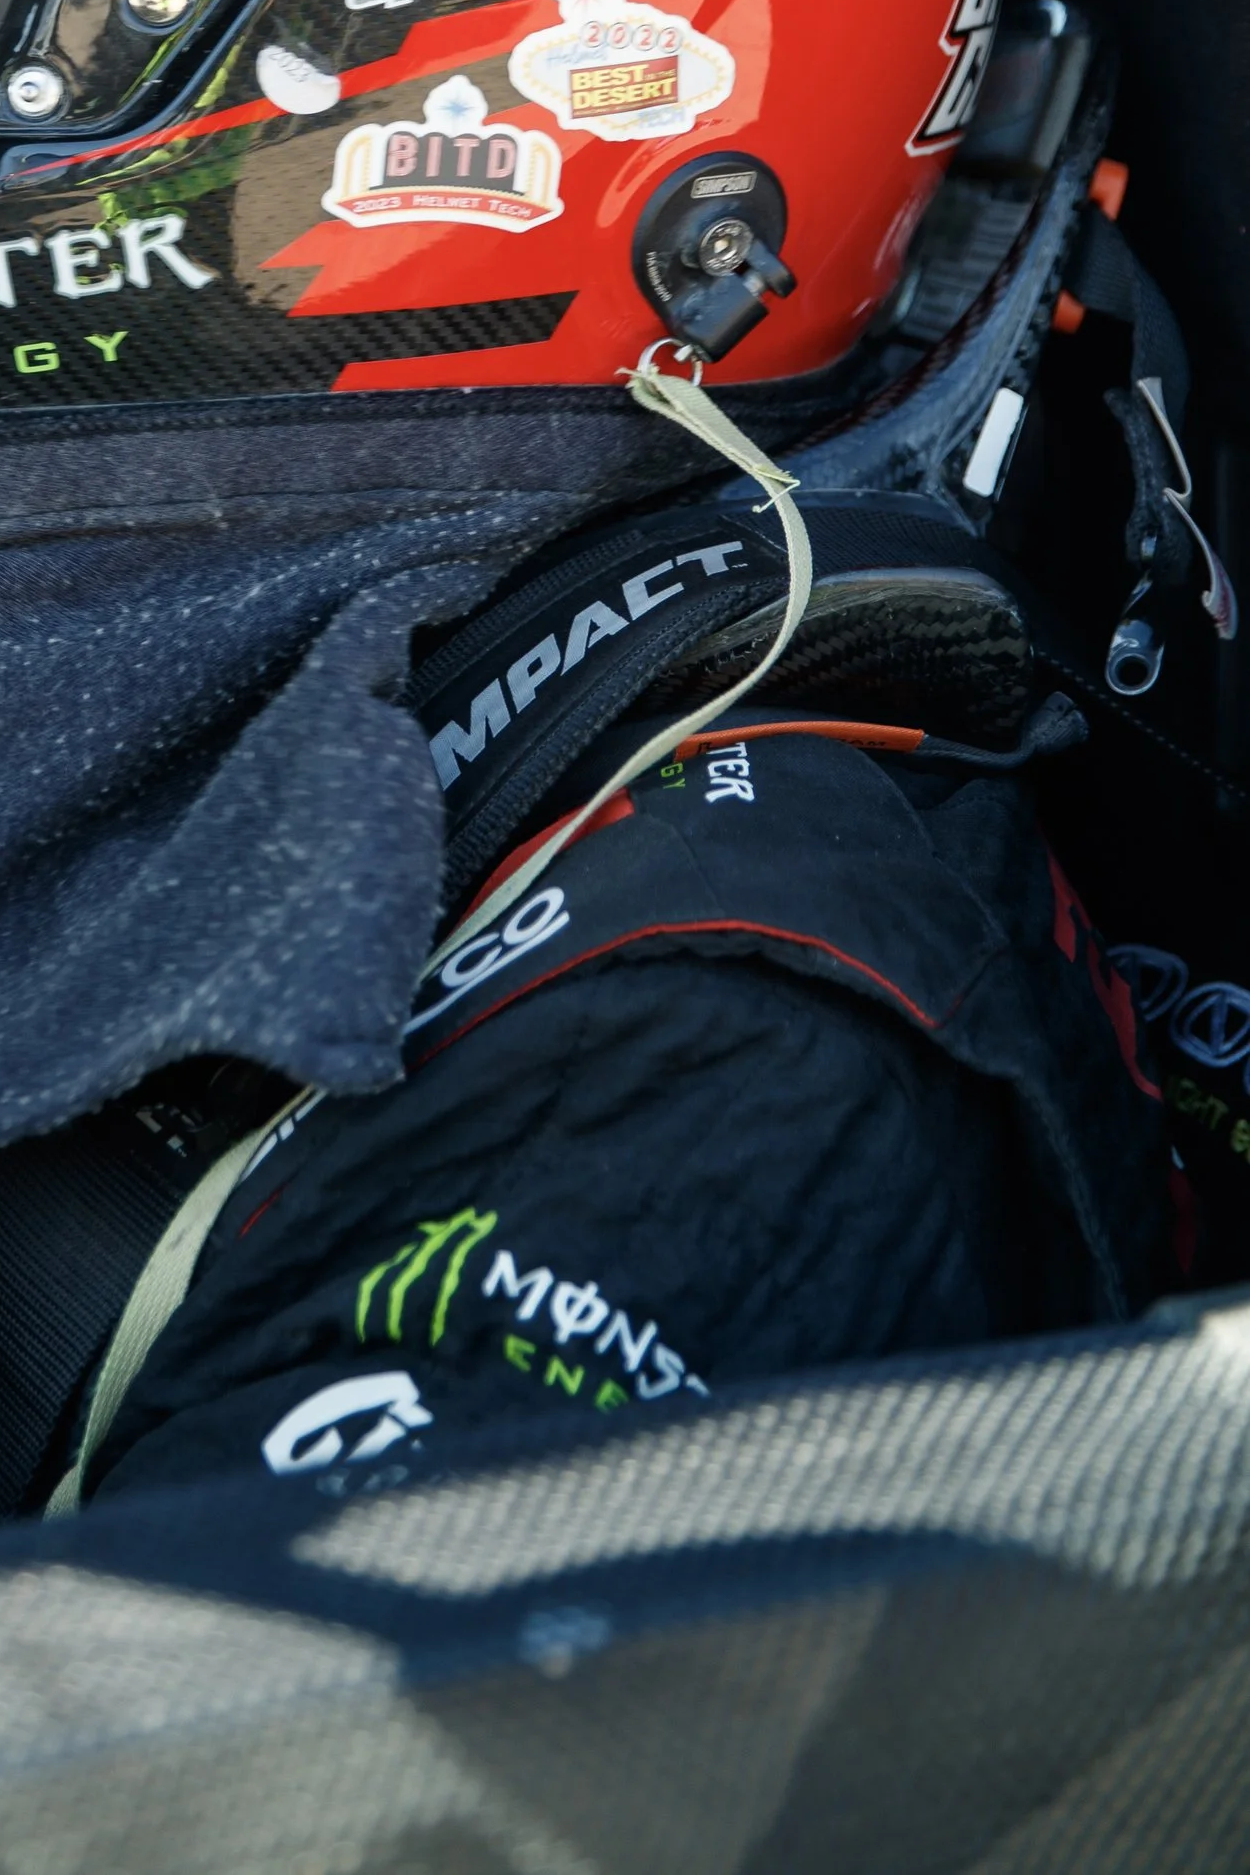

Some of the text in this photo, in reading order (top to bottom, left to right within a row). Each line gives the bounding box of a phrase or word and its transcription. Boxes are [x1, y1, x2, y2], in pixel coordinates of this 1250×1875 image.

[587, 24, 678, 49] 2022
[571, 64, 649, 92] BEST
[572, 77, 678, 110] DESERT
[386, 134, 517, 179] BITD
[352, 196, 402, 213] 2023
[481, 1249, 710, 1400] MONS
